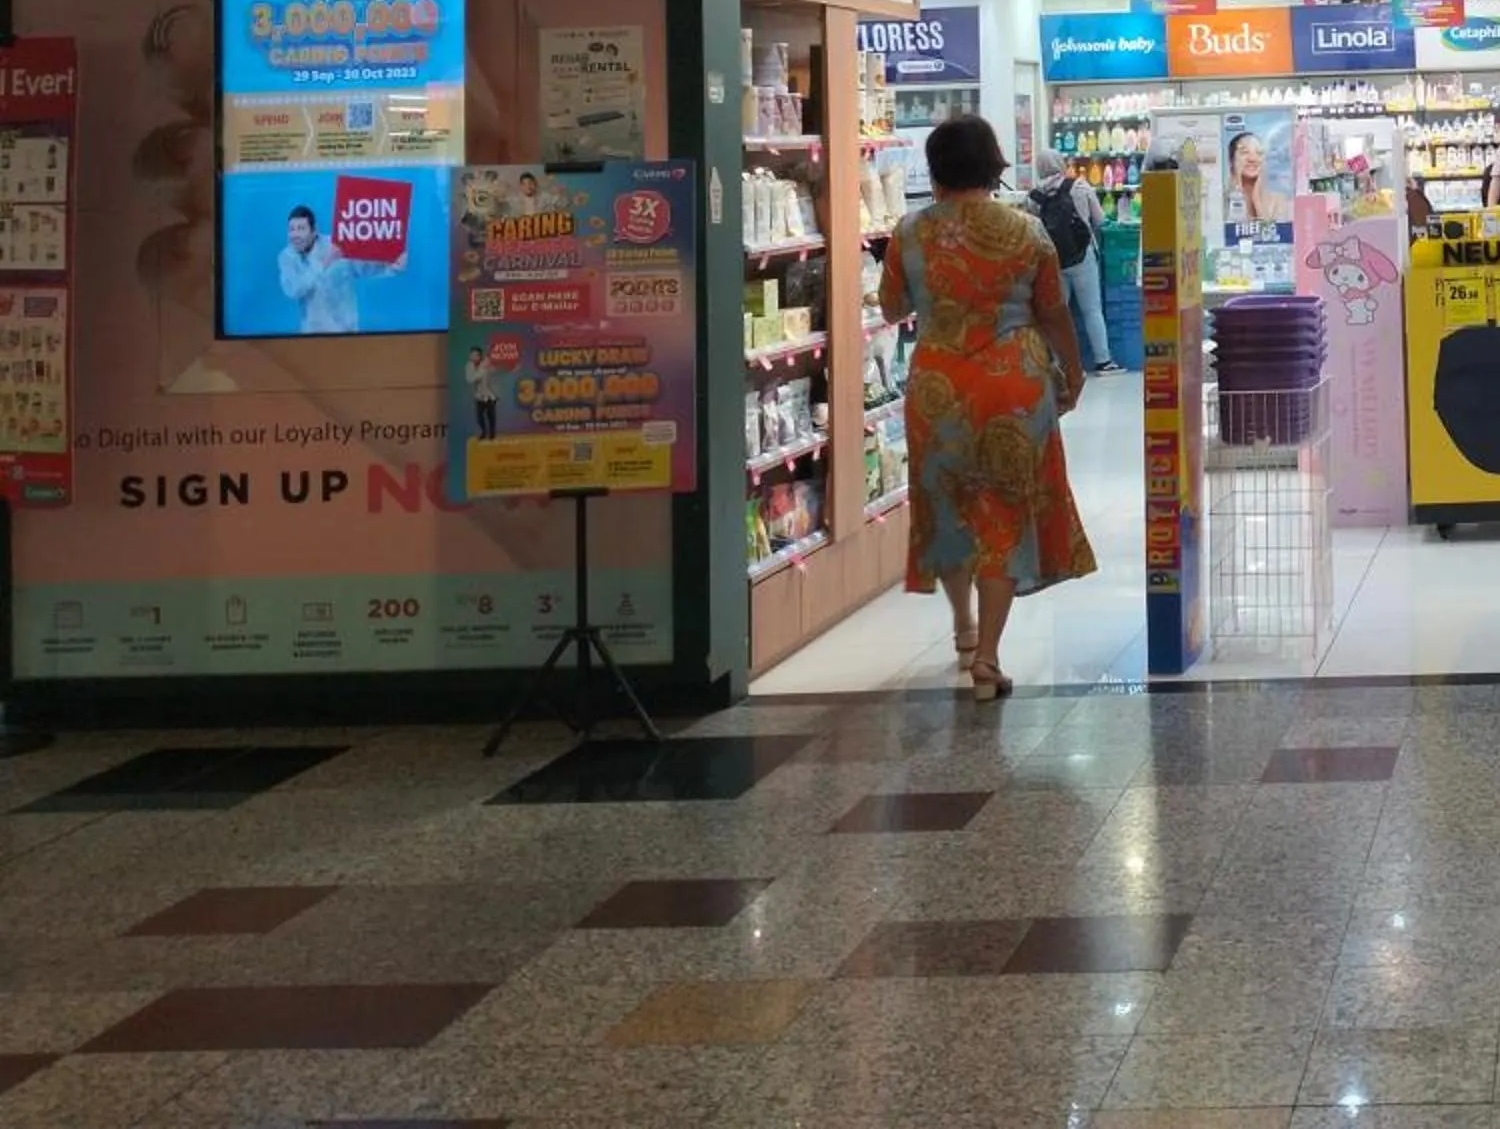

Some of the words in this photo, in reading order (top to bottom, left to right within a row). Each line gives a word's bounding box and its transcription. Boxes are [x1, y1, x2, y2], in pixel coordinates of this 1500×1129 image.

[1188, 23, 1266, 55] Buds
[1317, 21, 1388, 49] Linola
[1449, 24, 1500, 41] Cetaphil
[11, 67, 74, 97] Ever!
[362, 68, 383, 81] Oct
[340, 197, 397, 220] JOIN
[337, 217, 402, 242] NOW!
[488, 212, 576, 242] CARING
[1144, 252, 1172, 314] FUN
[538, 349, 594, 367] LUCKY
[1145, 342, 1174, 402] THE
[75, 434, 91, 449] o
[98, 426, 169, 454] Digital
[176, 424, 222, 448] with
[229, 429, 267, 446] our
[274, 421, 354, 450] Loyalty
[120, 473, 250, 508] SIGN
[281, 471, 348, 504] UP
[1147, 432, 1178, 591] PROTECT
[367, 598, 420, 619] 200
